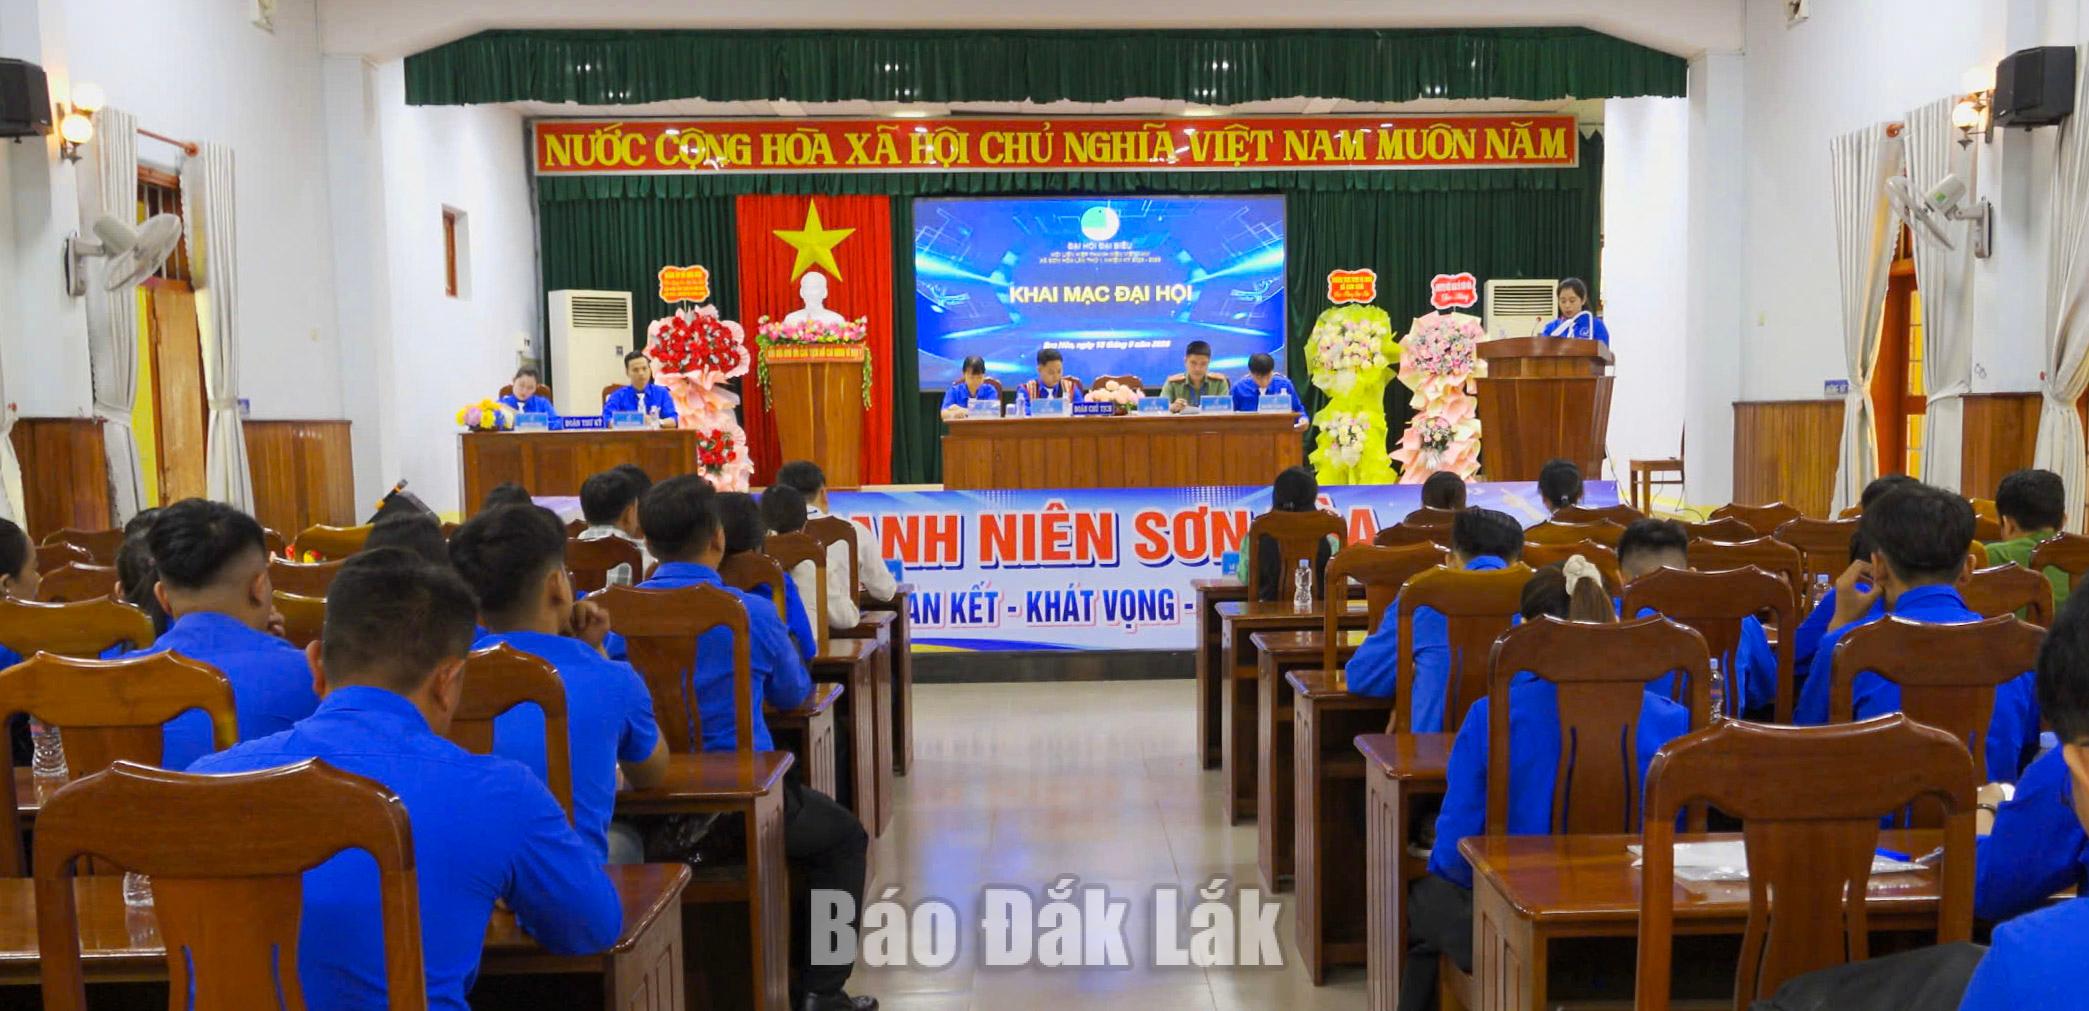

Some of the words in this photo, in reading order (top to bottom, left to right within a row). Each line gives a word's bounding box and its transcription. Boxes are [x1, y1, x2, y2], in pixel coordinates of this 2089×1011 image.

[544, 122, 647, 166] NƯỚC
[655, 127, 752, 170] CỘNG
[760, 127, 838, 165] HÒA
[844, 124, 902, 165] XÃ
[908, 126, 970, 168] HỘI
[979, 121, 1054, 164] CHỦ
[1063, 122, 1180, 163] NGHĨA
[1185, 123, 1274, 167] VIỆT
[1283, 128, 1367, 161] NAM
[1375, 122, 1476, 160] MUÔN
[1484, 121, 1567, 159] NĂM
[1009, 286, 1059, 304] KHAI
[1064, 286, 1110, 305] MẠC
[1114, 285, 1149, 305] ĐẠI
[1156, 284, 1193, 304] HỘI
[979, 502, 1113, 562] NIÊN
[1134, 506, 1249, 561] SƠN
[951, 582, 999, 624] KẾT
[1026, 583, 1094, 623] KHÁT
[1102, 588, 1175, 630] VỌNG
